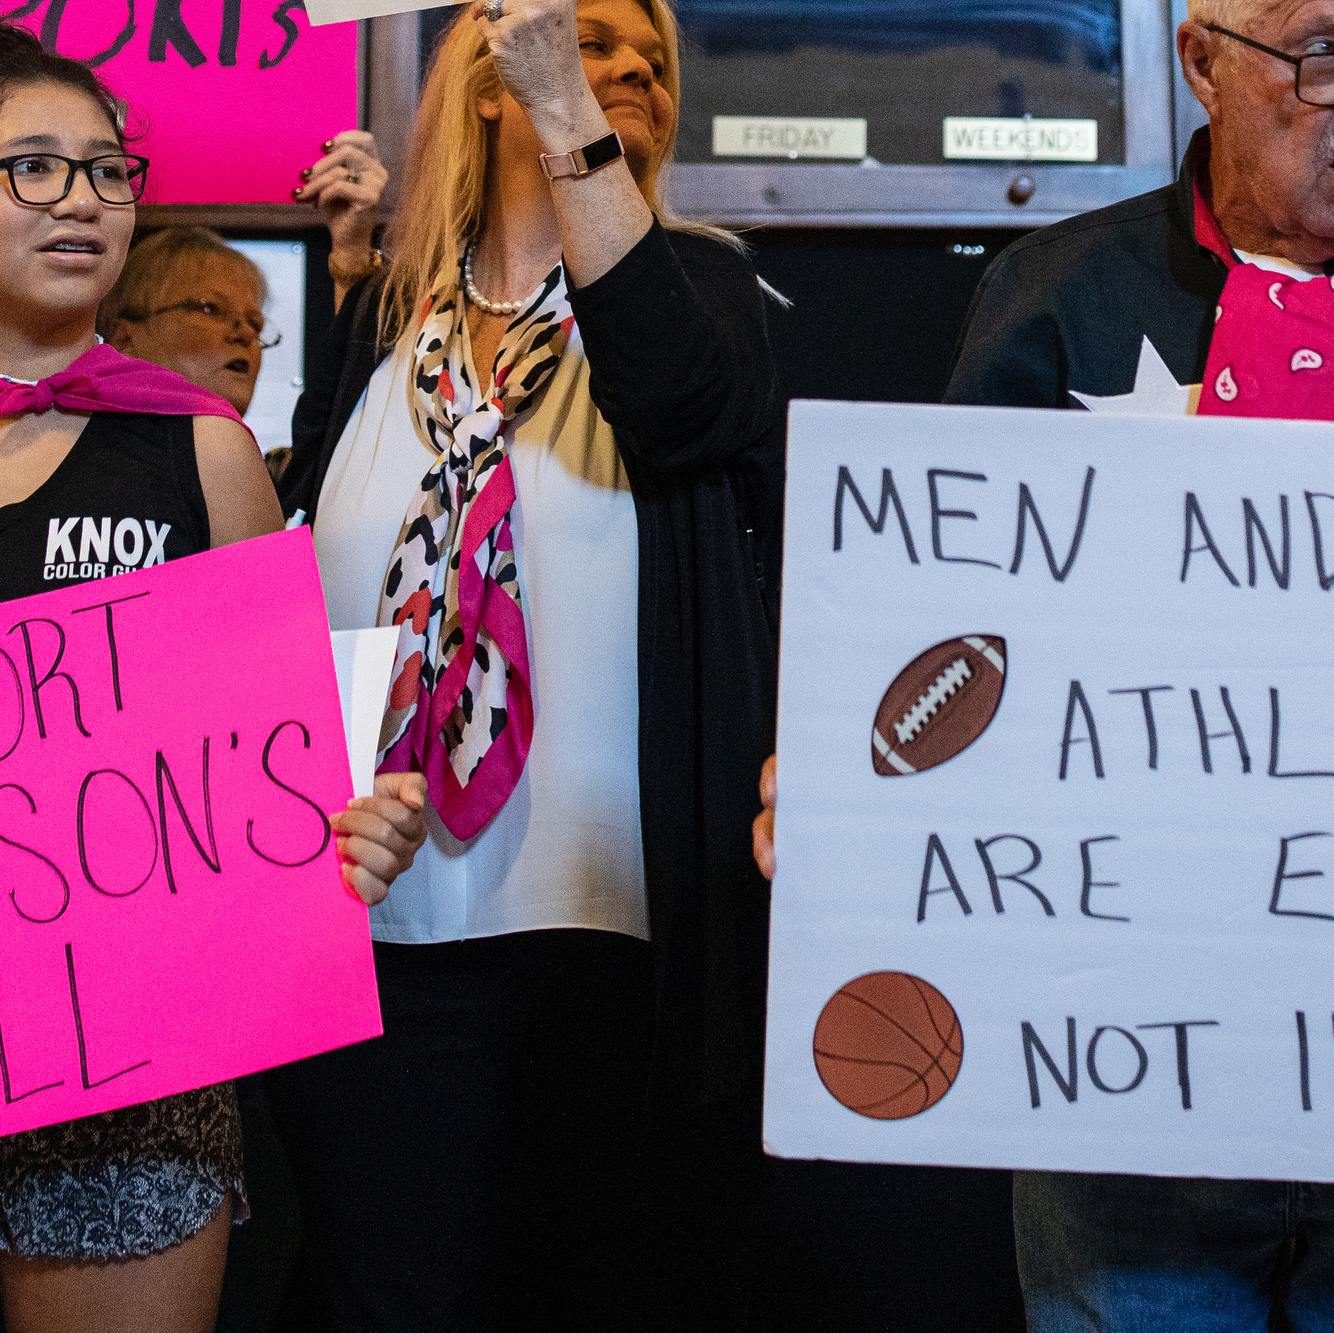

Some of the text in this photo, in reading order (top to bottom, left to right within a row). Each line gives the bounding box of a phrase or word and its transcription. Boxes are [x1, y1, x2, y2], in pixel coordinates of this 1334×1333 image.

[741, 124, 836, 150] FRIDAY
[951, 126, 1090, 152] WEEKENDS
[44, 516, 173, 569] KNOX
[831, 465, 1095, 583] MEN
[42, 562, 107, 581] COLOR
[916, 832, 1133, 925] ARE
[1020, 1016, 1221, 1112] NOT
